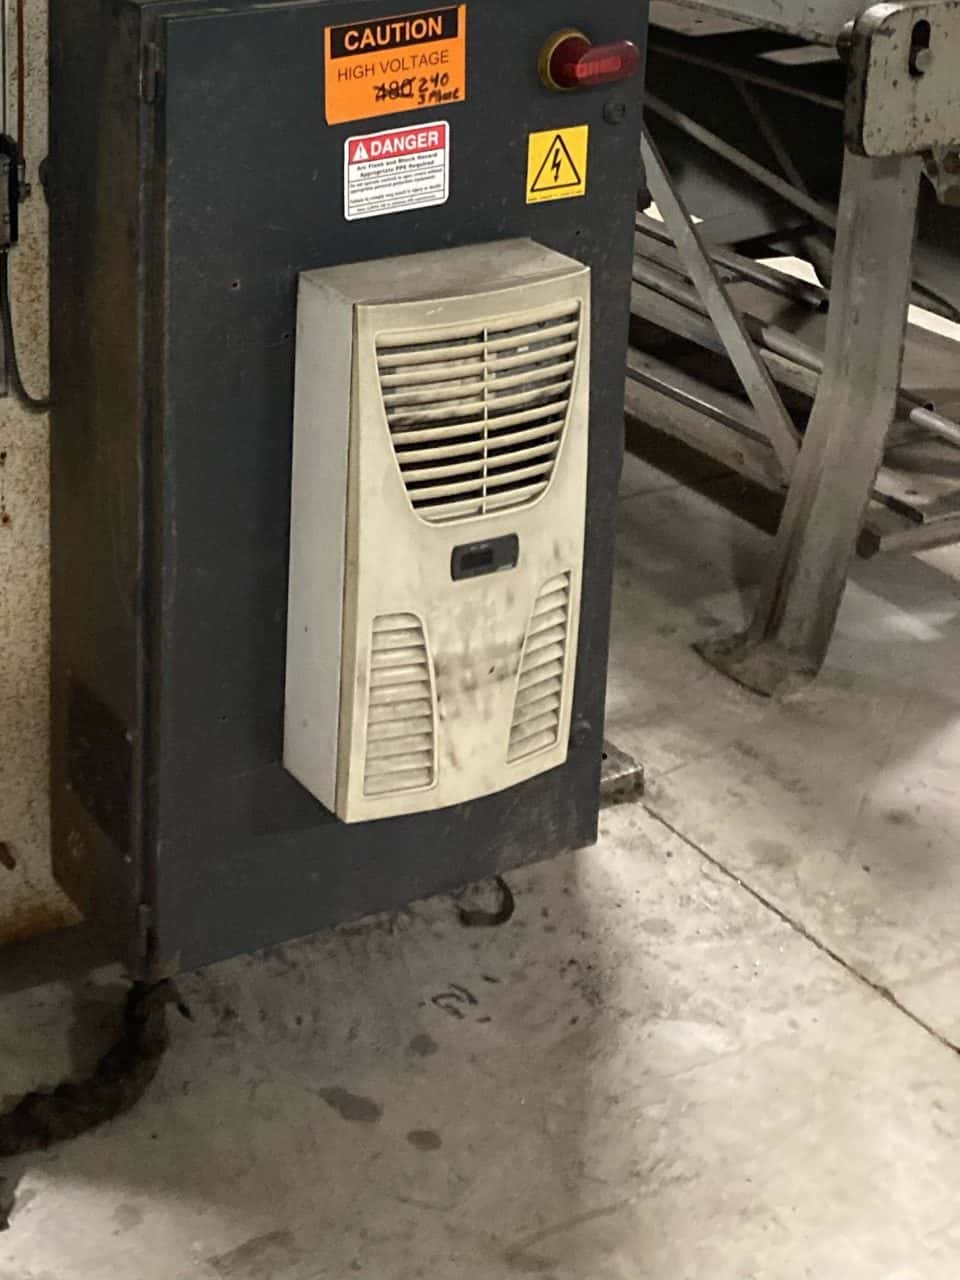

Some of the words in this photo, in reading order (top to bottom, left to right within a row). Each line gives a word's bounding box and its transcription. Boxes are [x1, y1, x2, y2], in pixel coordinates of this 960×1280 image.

[344, 16, 442, 51] CAUTION
[337, 64, 375, 82] HIGH
[380, 49, 449, 74] VOLTAGE
[418, 72, 450, 93] 240
[418, 93, 426, 105] 3
[370, 130, 438, 156] DANGER
